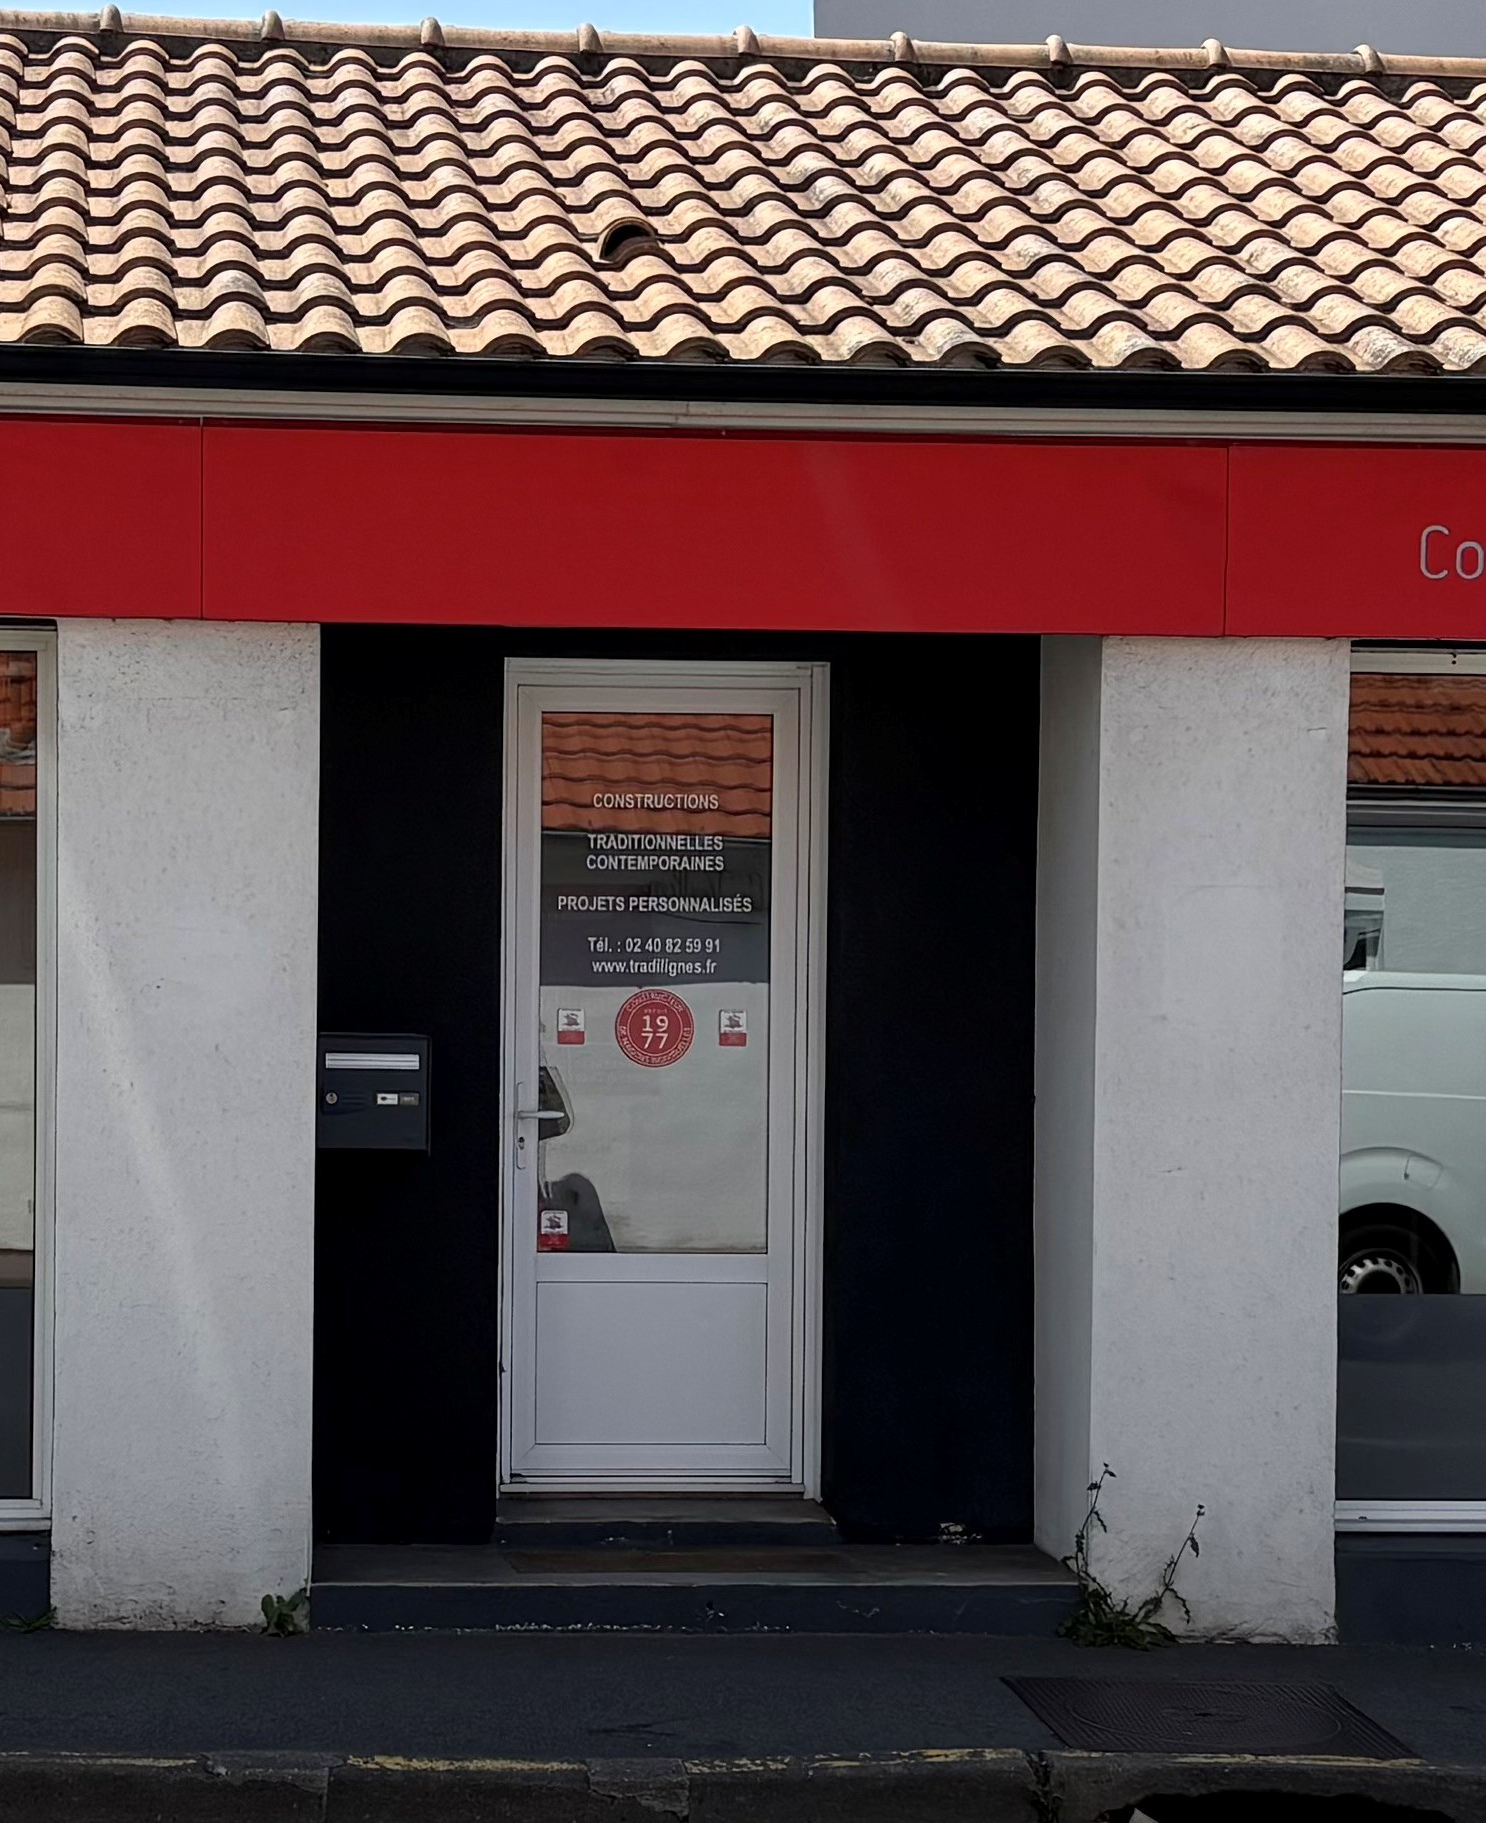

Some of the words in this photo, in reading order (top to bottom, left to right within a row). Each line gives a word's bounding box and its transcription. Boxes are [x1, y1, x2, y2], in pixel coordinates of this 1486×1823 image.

[593, 793, 719, 810] CONSTRUCTIONS
[587, 833, 724, 850] TRADITIONNELLES
[586, 855, 724, 871] CONTEMPORAINES
[557, 895, 625, 912] PROJETS
[629, 894, 752, 913] PERSONNALISÉS
[587, 937, 612, 953] Tél.
[625, 939, 641, 953] 02
[645, 939, 662, 953] 40
[665, 939, 682, 953] 82
[685, 939, 702, 953] 59
[705, 939, 720, 953] 91
[591, 958, 717, 977] www.tradilignes.fr
[643, 1015, 669, 1032] 19
[641, 1033, 668, 1049] 77
